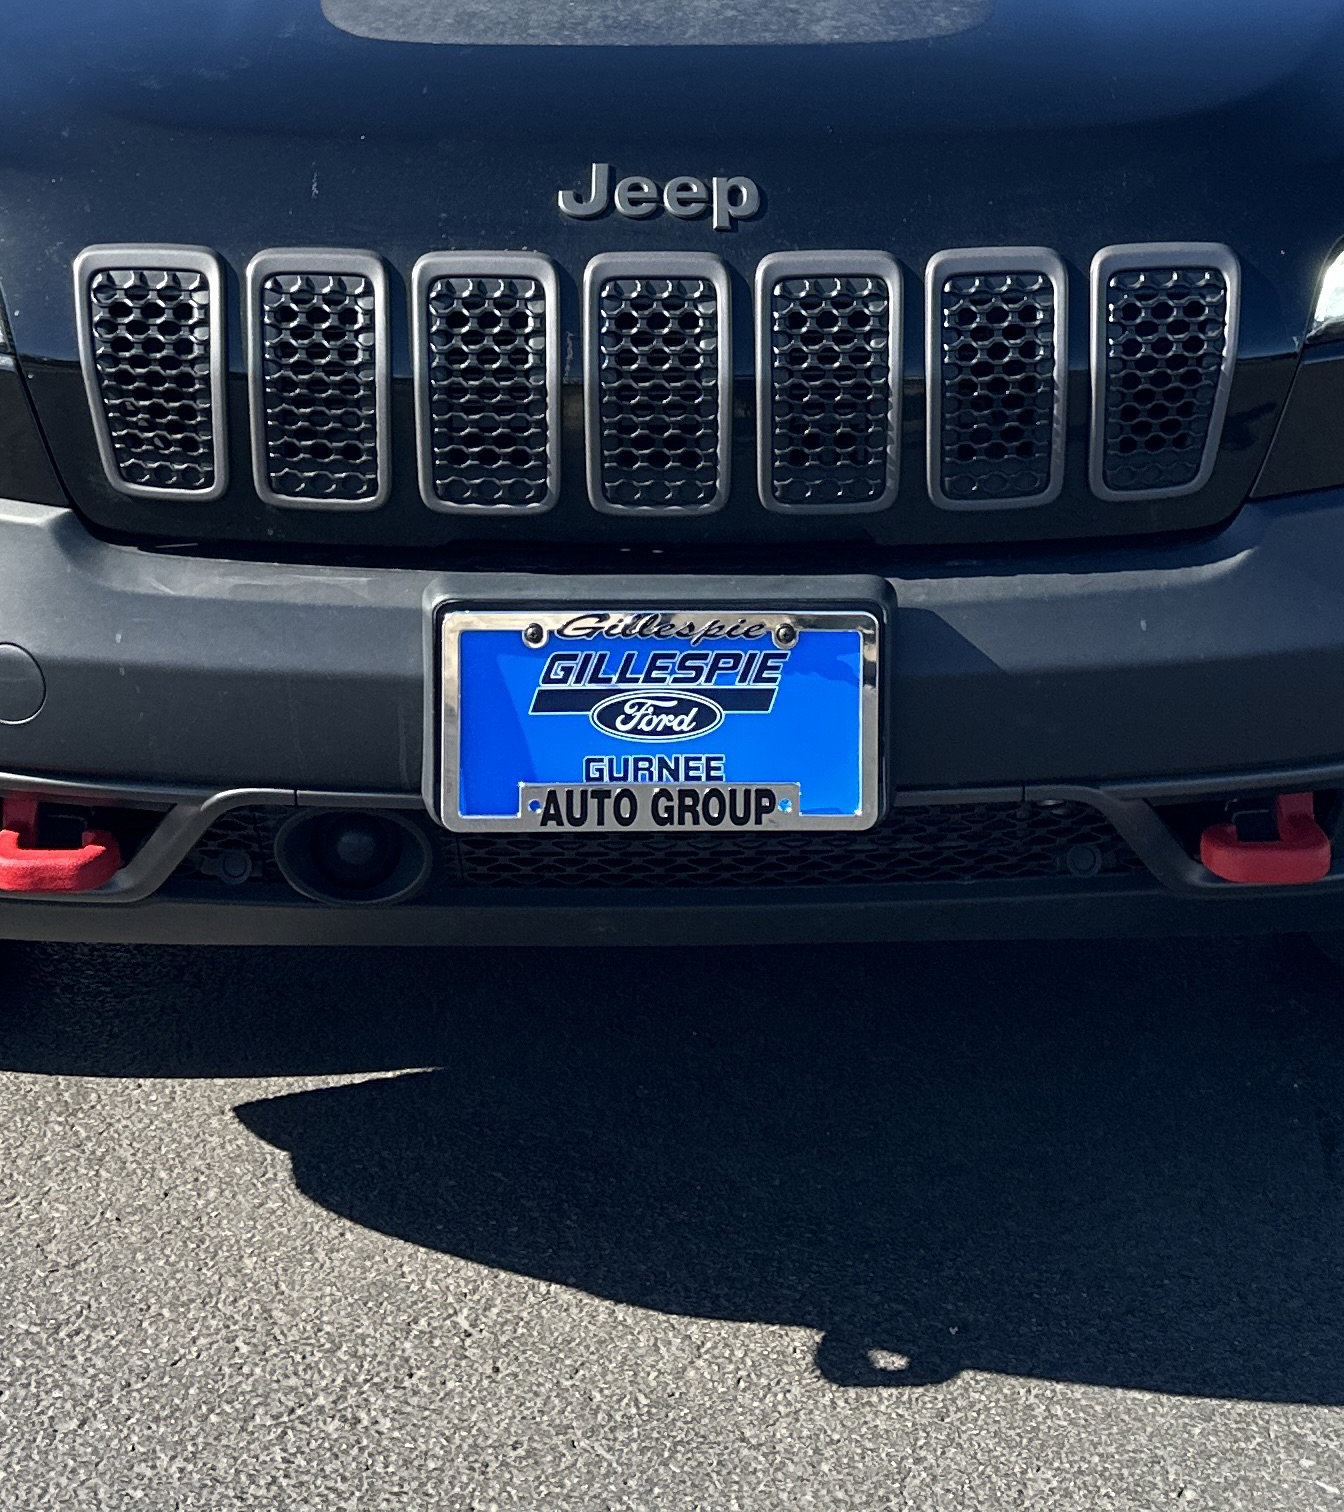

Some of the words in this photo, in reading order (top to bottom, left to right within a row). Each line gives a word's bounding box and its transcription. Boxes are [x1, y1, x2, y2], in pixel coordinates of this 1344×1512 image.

[557, 162, 761, 231] Jeep
[556, 612, 768, 646] Gillespie
[538, 649, 792, 687] GILLESPIE
[614, 696, 700, 733] Ford
[582, 753, 727, 783] GURNEE
[539, 787, 639, 827] AUTO
[650, 786, 777, 827] GROUP
